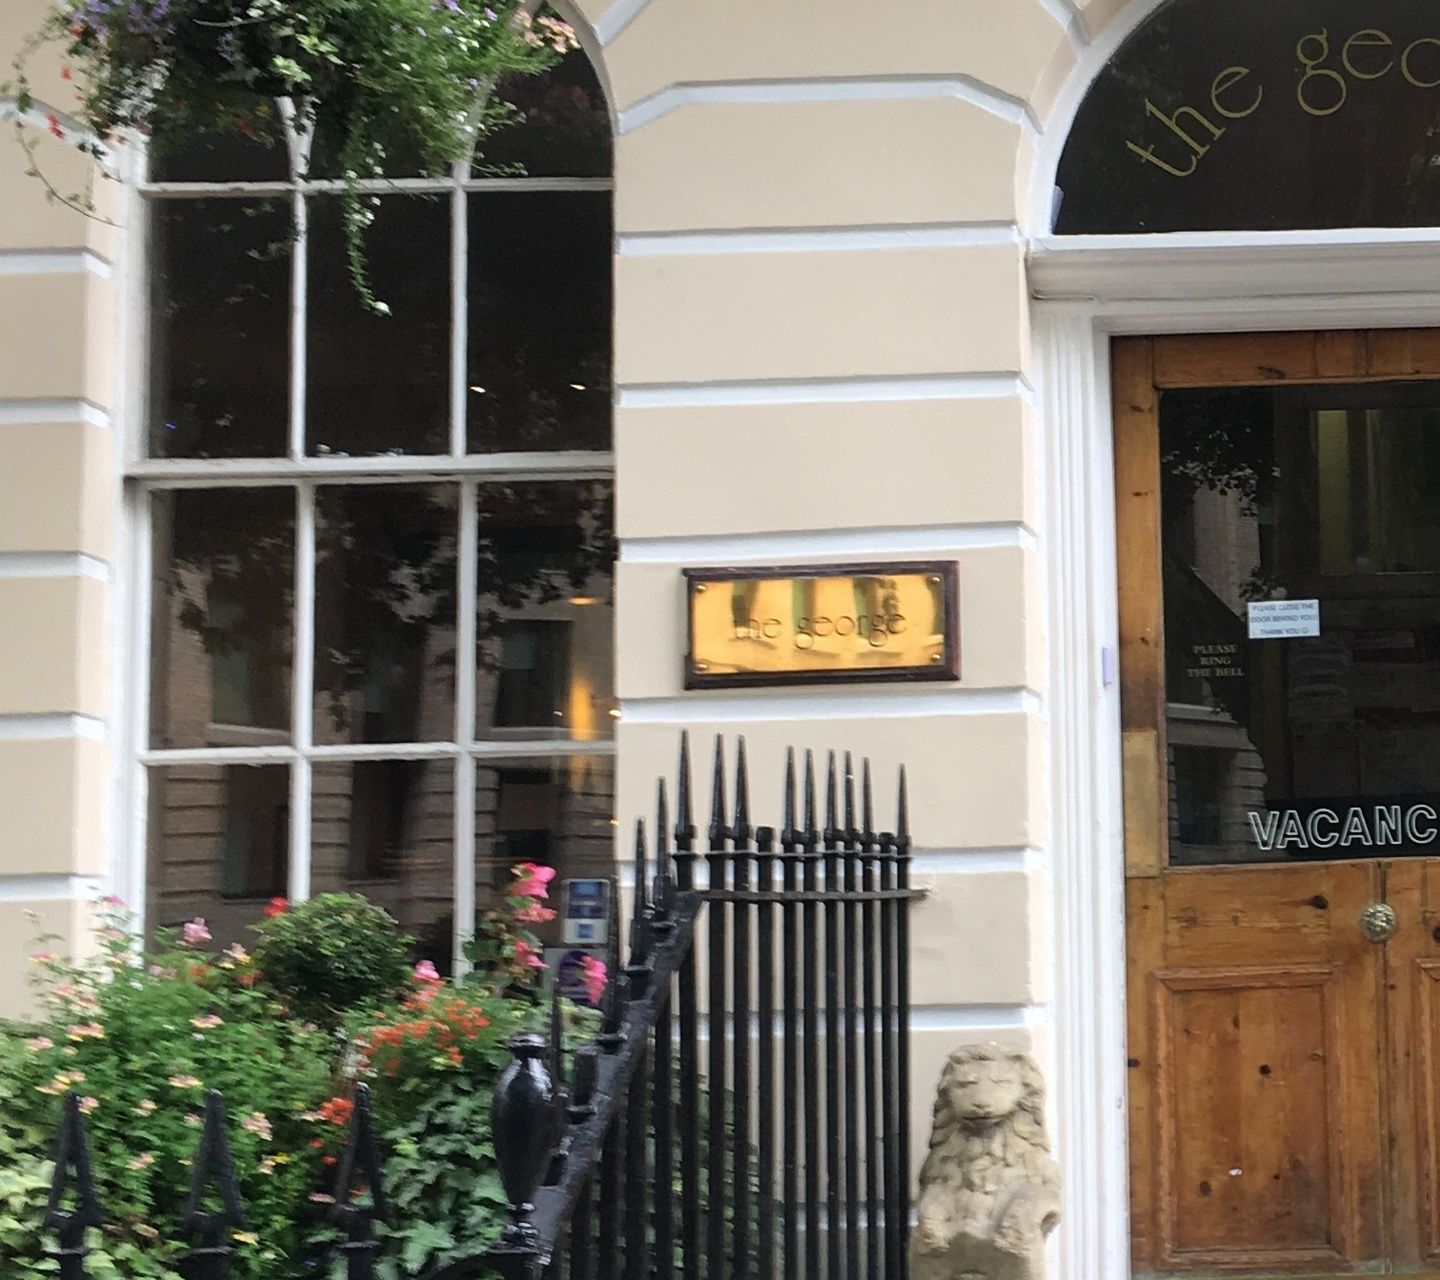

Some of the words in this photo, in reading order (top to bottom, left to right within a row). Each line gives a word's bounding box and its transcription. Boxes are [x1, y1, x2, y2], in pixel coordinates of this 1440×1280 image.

[1126, 65, 1263, 178] the
[795, 613, 907, 650] george
[1193, 643, 1238, 655] PLEASE
[1200, 656, 1231, 666] RING
[1186, 667, 1211, 678] THE
[1215, 667, 1245, 677] BELL
